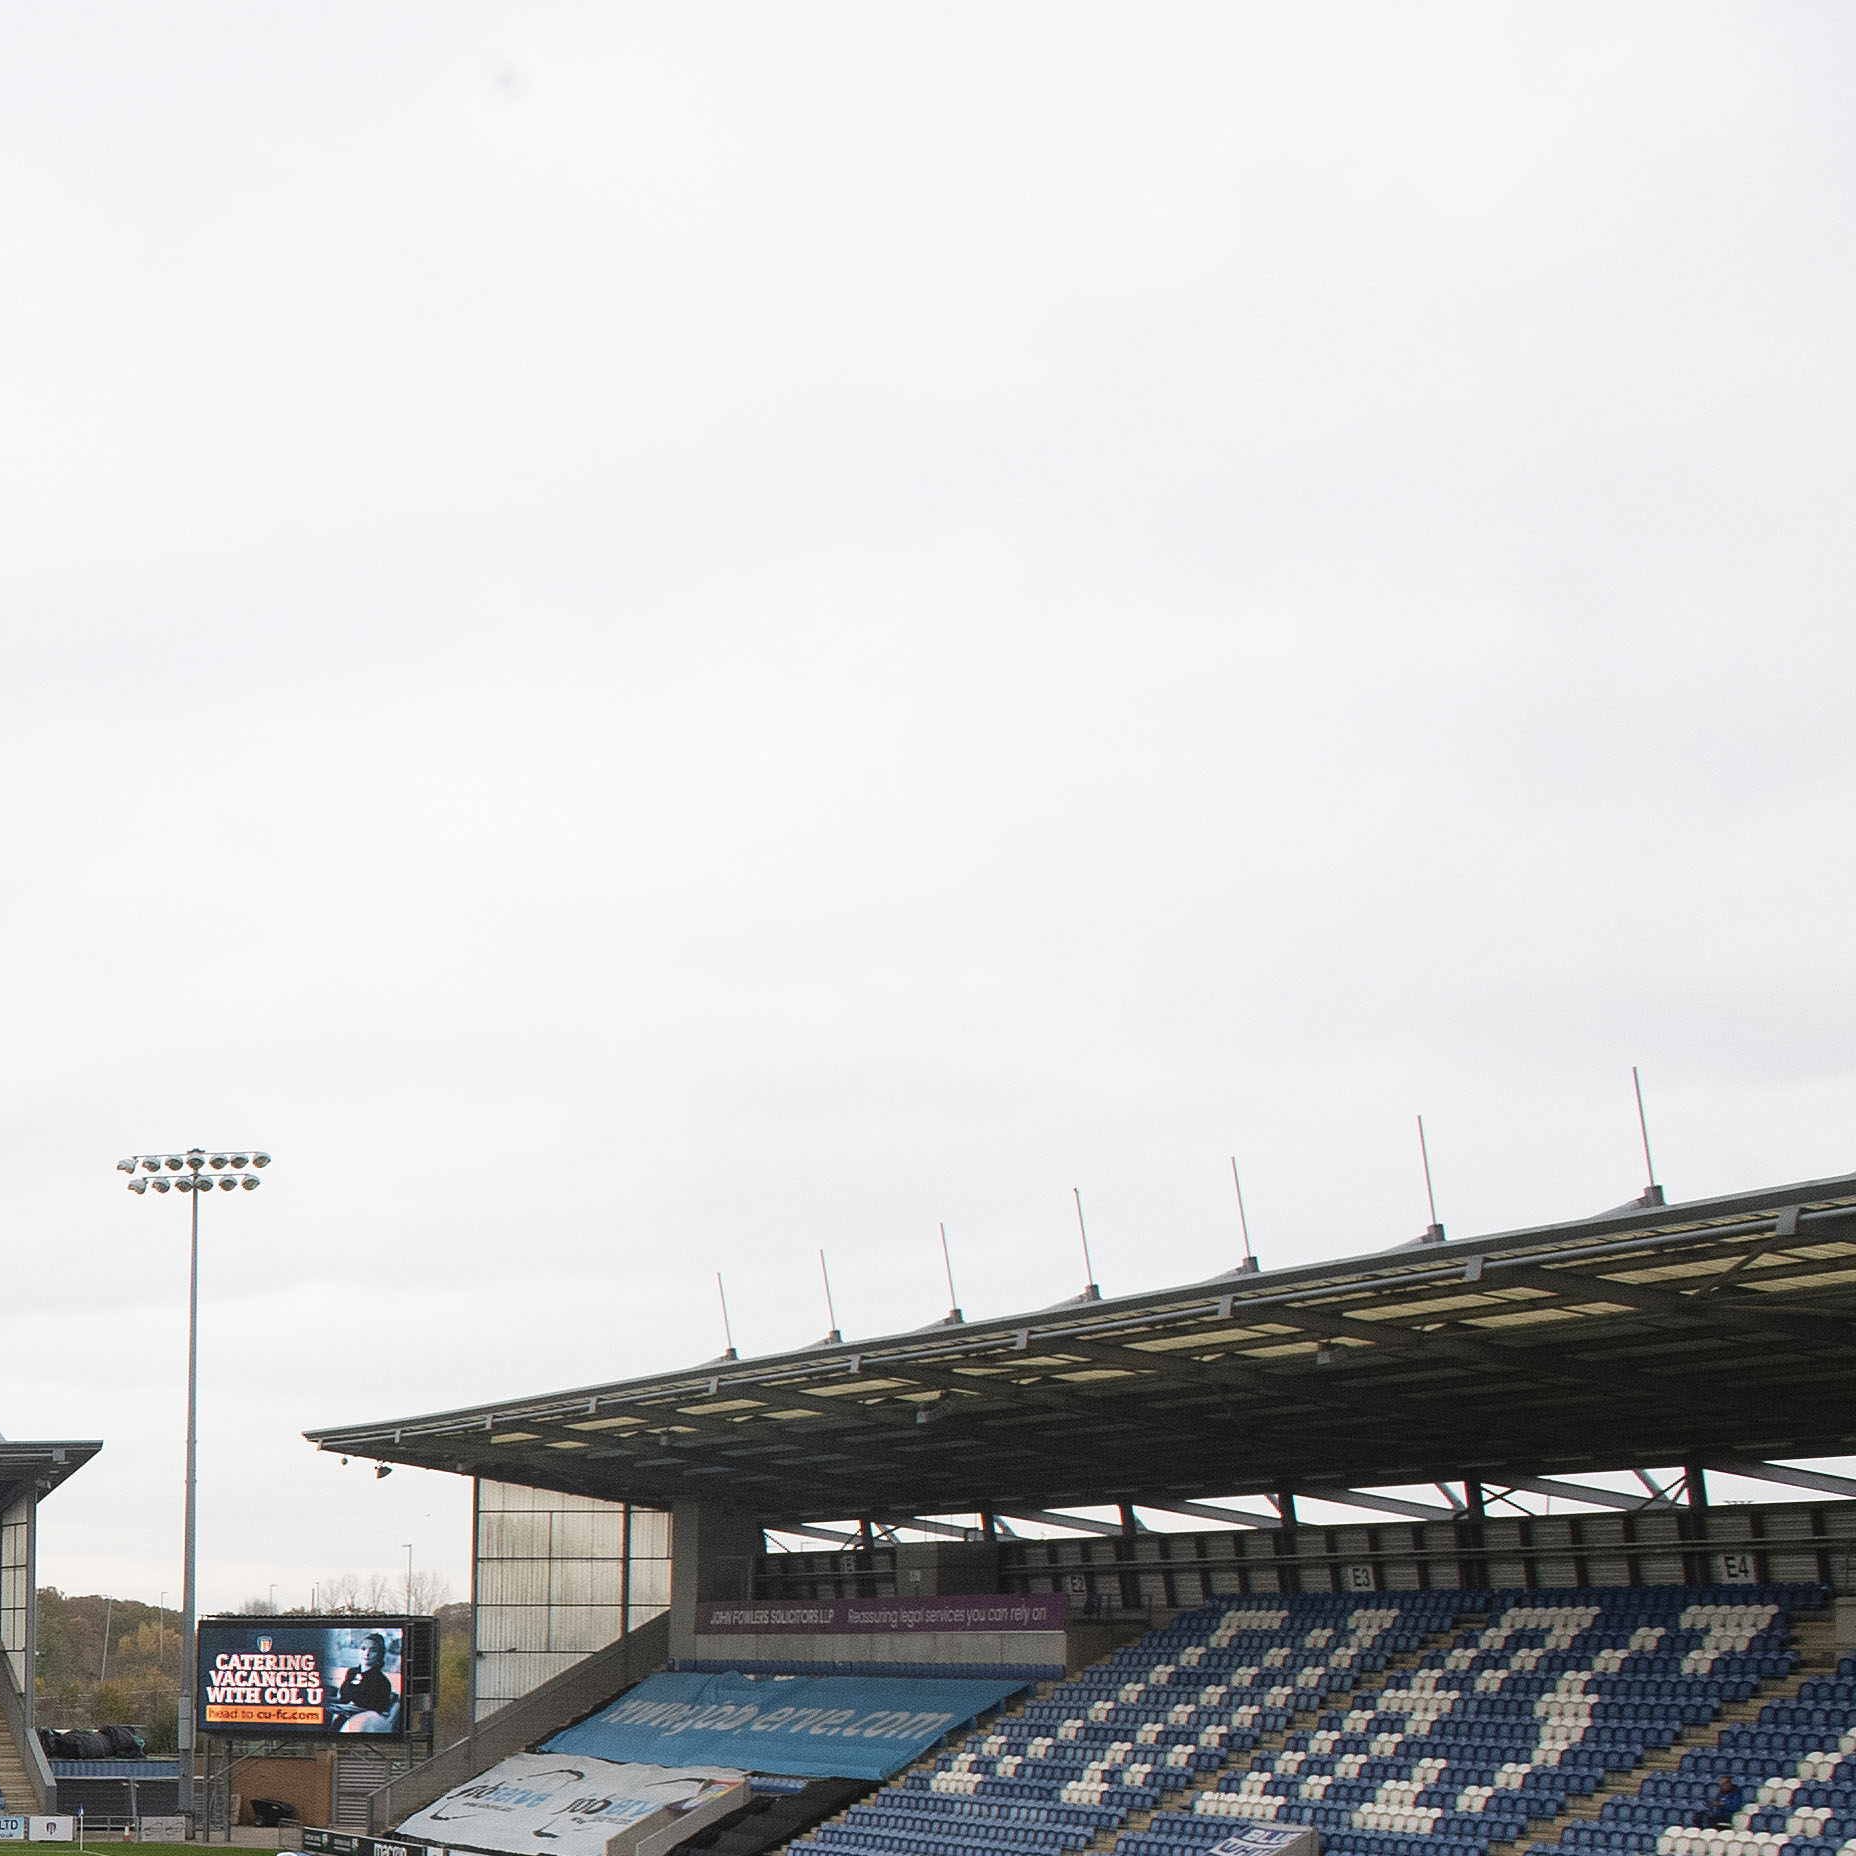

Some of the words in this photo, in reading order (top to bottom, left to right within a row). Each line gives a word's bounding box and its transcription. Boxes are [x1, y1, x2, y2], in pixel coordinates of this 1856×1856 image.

[1724, 1556, 1748, 1578] E4
[1353, 1568, 1371, 1587] E3
[215, 1653, 315, 1671] CATERING
[209, 1670, 322, 1687] VACANCIES
[206, 1686, 262, 1703] WITH
[264, 1687, 304, 1704] COL
[307, 1687, 324, 1704] U
[256, 1706, 320, 1720] cu-fc.com
